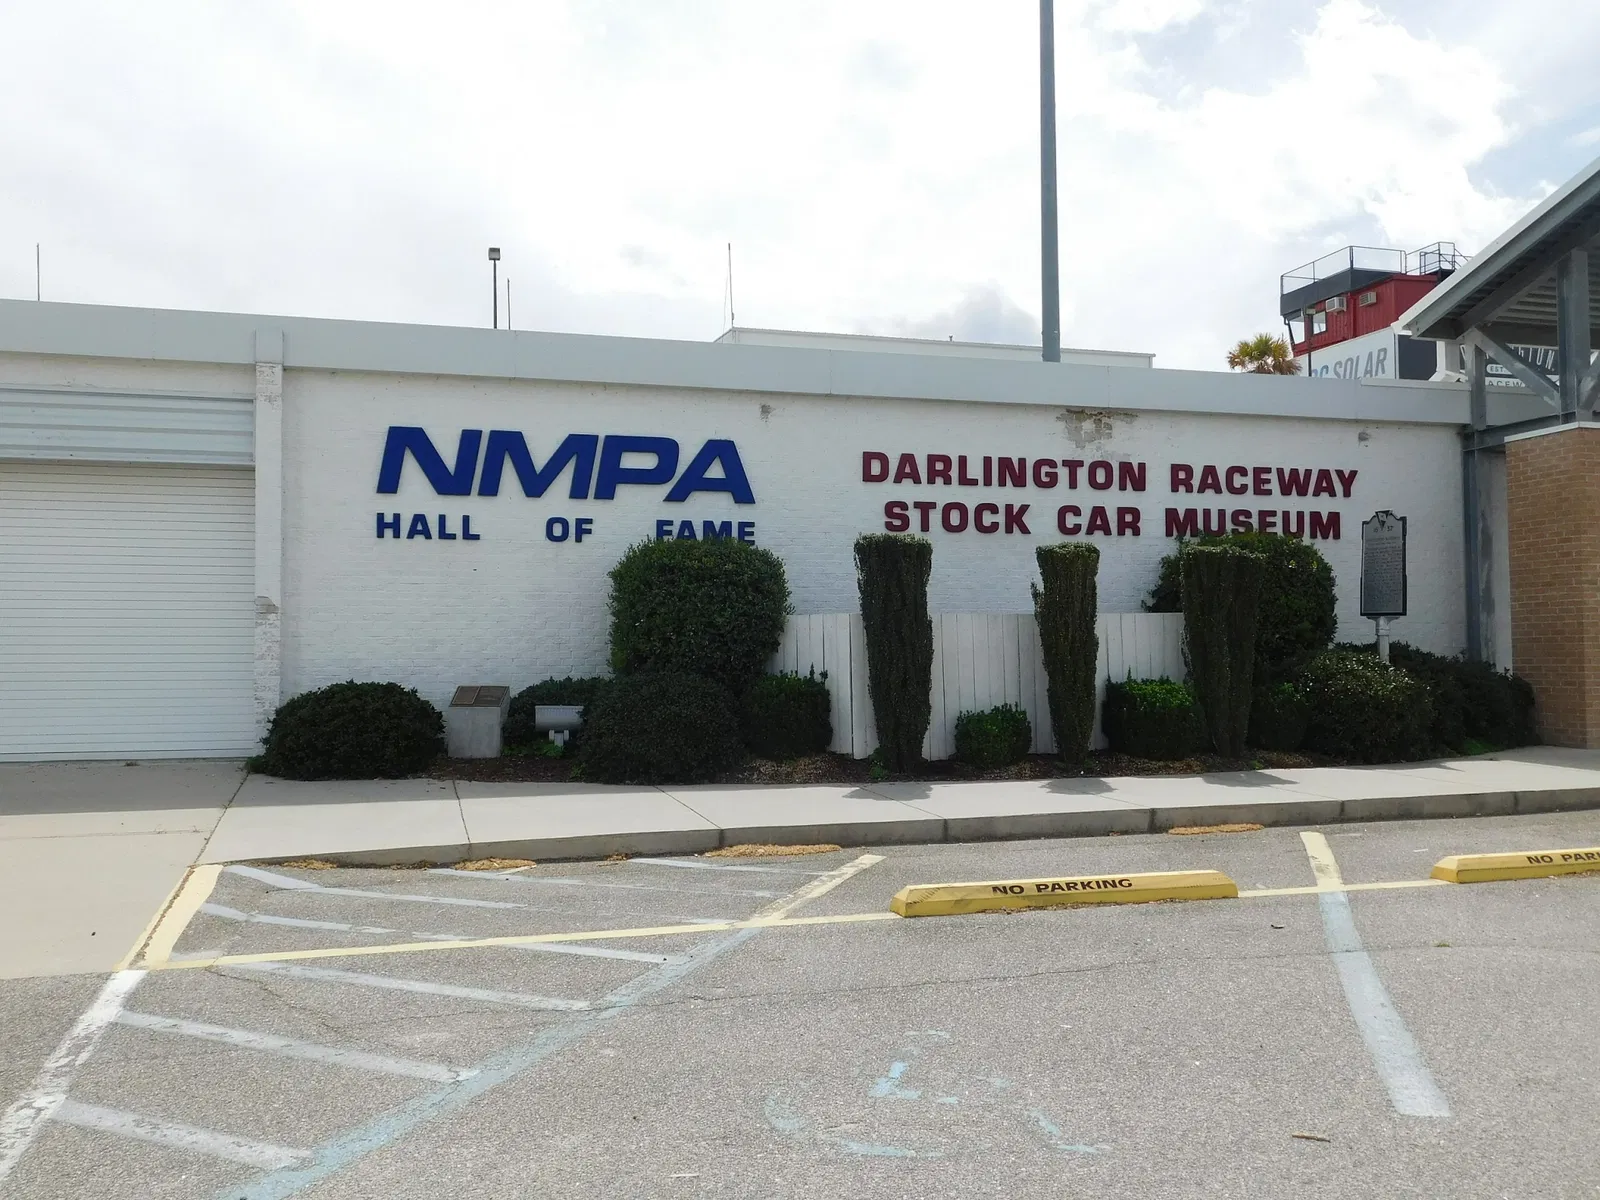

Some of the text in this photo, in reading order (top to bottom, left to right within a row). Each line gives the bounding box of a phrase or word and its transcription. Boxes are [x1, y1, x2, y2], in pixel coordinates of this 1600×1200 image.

[1333, 347, 1388, 379] SOLAR
[376, 426, 756, 504] NMPA
[862, 451, 1359, 498] DARLINGTON RACEWAY
[376, 512, 756, 546] HALL OF FAME
[884, 500, 1341, 540] STOCK CAR MUSEUM
[1527, 855, 1553, 864] NO
[991, 878, 1133, 895] NO PARKING
